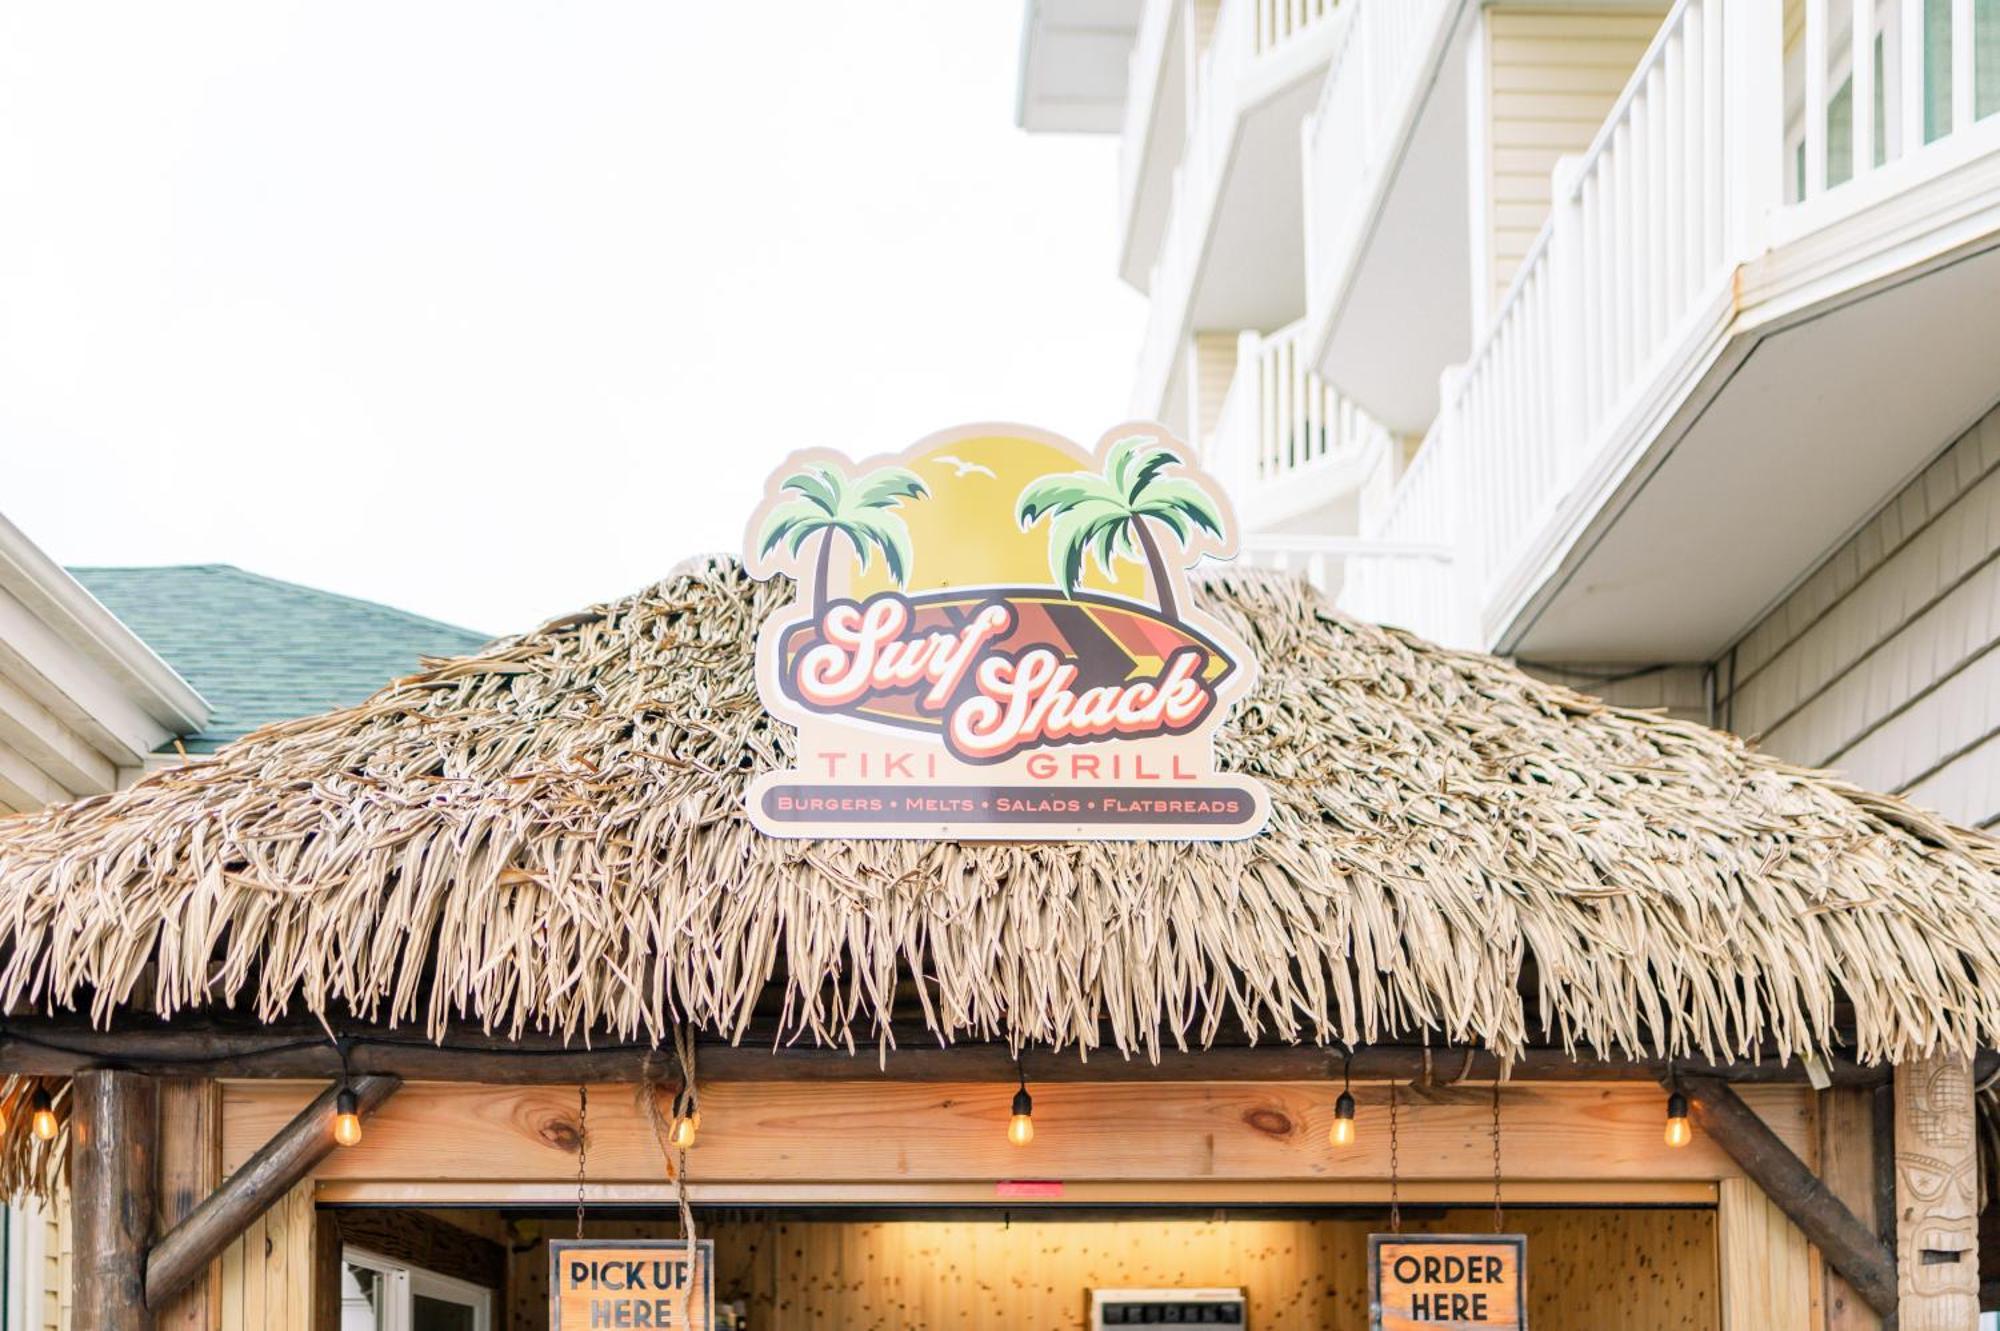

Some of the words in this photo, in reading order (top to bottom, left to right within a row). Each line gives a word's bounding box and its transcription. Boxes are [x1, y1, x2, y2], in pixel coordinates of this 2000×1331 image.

[798, 599, 1009, 708] Surf
[948, 650, 1208, 758] Shack
[819, 753, 935, 778] TIKI
[1027, 754, 1197, 779] GRILL
[1393, 1256, 1504, 1284] ORDER
[592, 1299, 671, 1328] HERE
[1412, 1293, 1488, 1321] HERE
